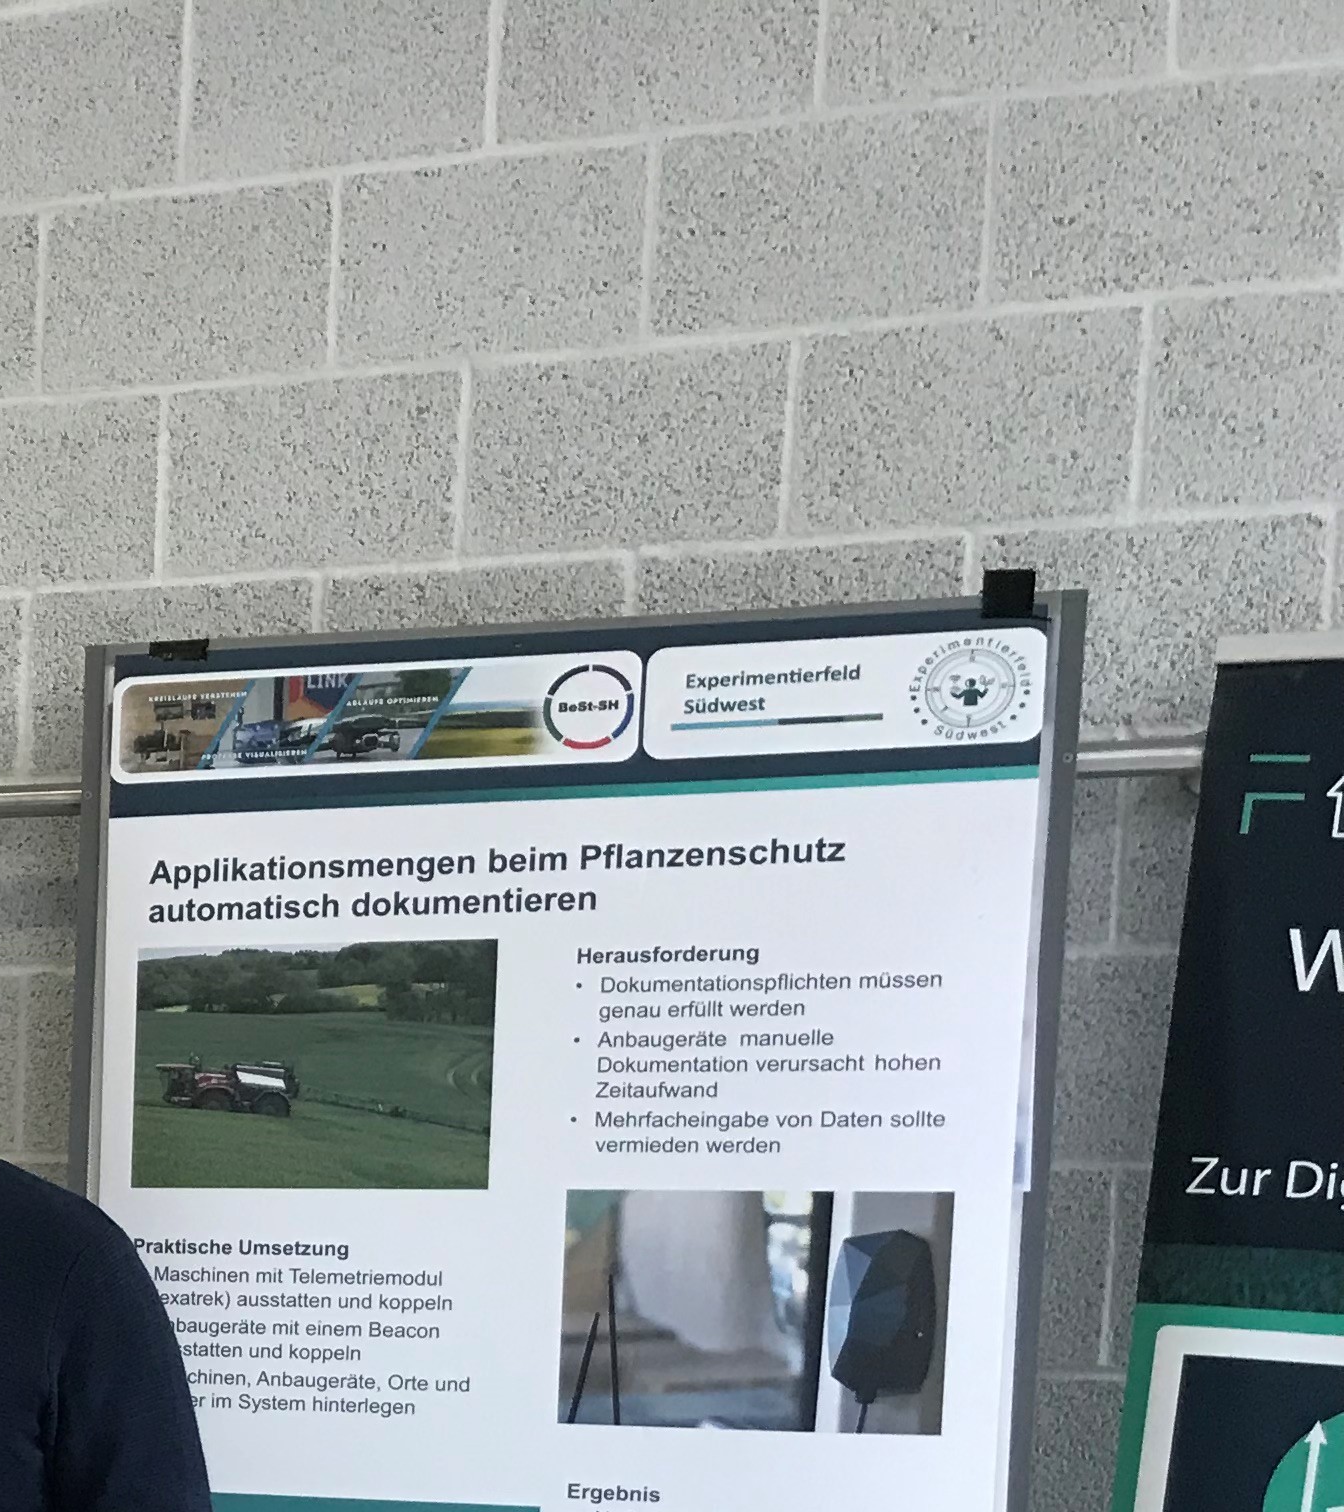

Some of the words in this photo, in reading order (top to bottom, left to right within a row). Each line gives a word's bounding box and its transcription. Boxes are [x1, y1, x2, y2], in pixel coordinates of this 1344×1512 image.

[685, 664, 861, 691] Experimentierfeld
[683, 696, 766, 715] Südwest
[148, 855, 476, 891] Applikationsmengen
[488, 846, 568, 874] beim
[580, 837, 846, 871] Pflanzenschutz
[148, 893, 340, 924] automatisch
[351, 887, 597, 918] dokumentieren
[577, 945, 760, 966] Herausforderung
[600, 973, 851, 995] Dokumentationspflichten
[859, 971, 943, 989] müssen
[598, 1005, 661, 1024] genau
[667, 1000, 724, 1018] erfüllt
[729, 999, 805, 1017] werden
[597, 1030, 727, 1052] Anbaugeräte
[739, 1028, 835, 1047] manuelle
[597, 1056, 748, 1074] Dokumentation
[755, 1054, 865, 1073] verursacht
[874, 1053, 941, 1072] hohen
[595, 1081, 718, 1099] Zeitaufwand
[595, 1110, 769, 1133] Mehrfacheingabe
[775, 1114, 813, 1128] von
[820, 1110, 883, 1128] Daten
[890, 1110, 946, 1128] sollte
[595, 1136, 699, 1154] vermieden
[705, 1136, 781, 1154] werden
[1184, 1154, 1272, 1199] Zur
[134, 1238, 233, 1256] Praktische
[238, 1238, 349, 1261] Umsetzung
[153, 1265, 250, 1283] Maschinen
[255, 1268, 283, 1284] mit
[288, 1267, 443, 1287] Telemetriemodul
[236, 1292, 332, 1309] ausstatten
[338, 1293, 372, 1310] und
[378, 1293, 453, 1314] koppeln
[272, 1320, 300, 1336] mit
[305, 1323, 362, 1337] einem
[368, 1321, 440, 1339] Beacon
[248, 1343, 283, 1360] und
[288, 1343, 361, 1364] koppeln
[255, 1370, 381, 1393] Anbaugeräte,
[387, 1373, 429, 1392] Orte
[435, 1376, 471, 1393] und
[238, 1393, 306, 1414] System
[312, 1395, 416, 1419] hinterlegen
[567, 1483, 661, 1505] Ergebnis
